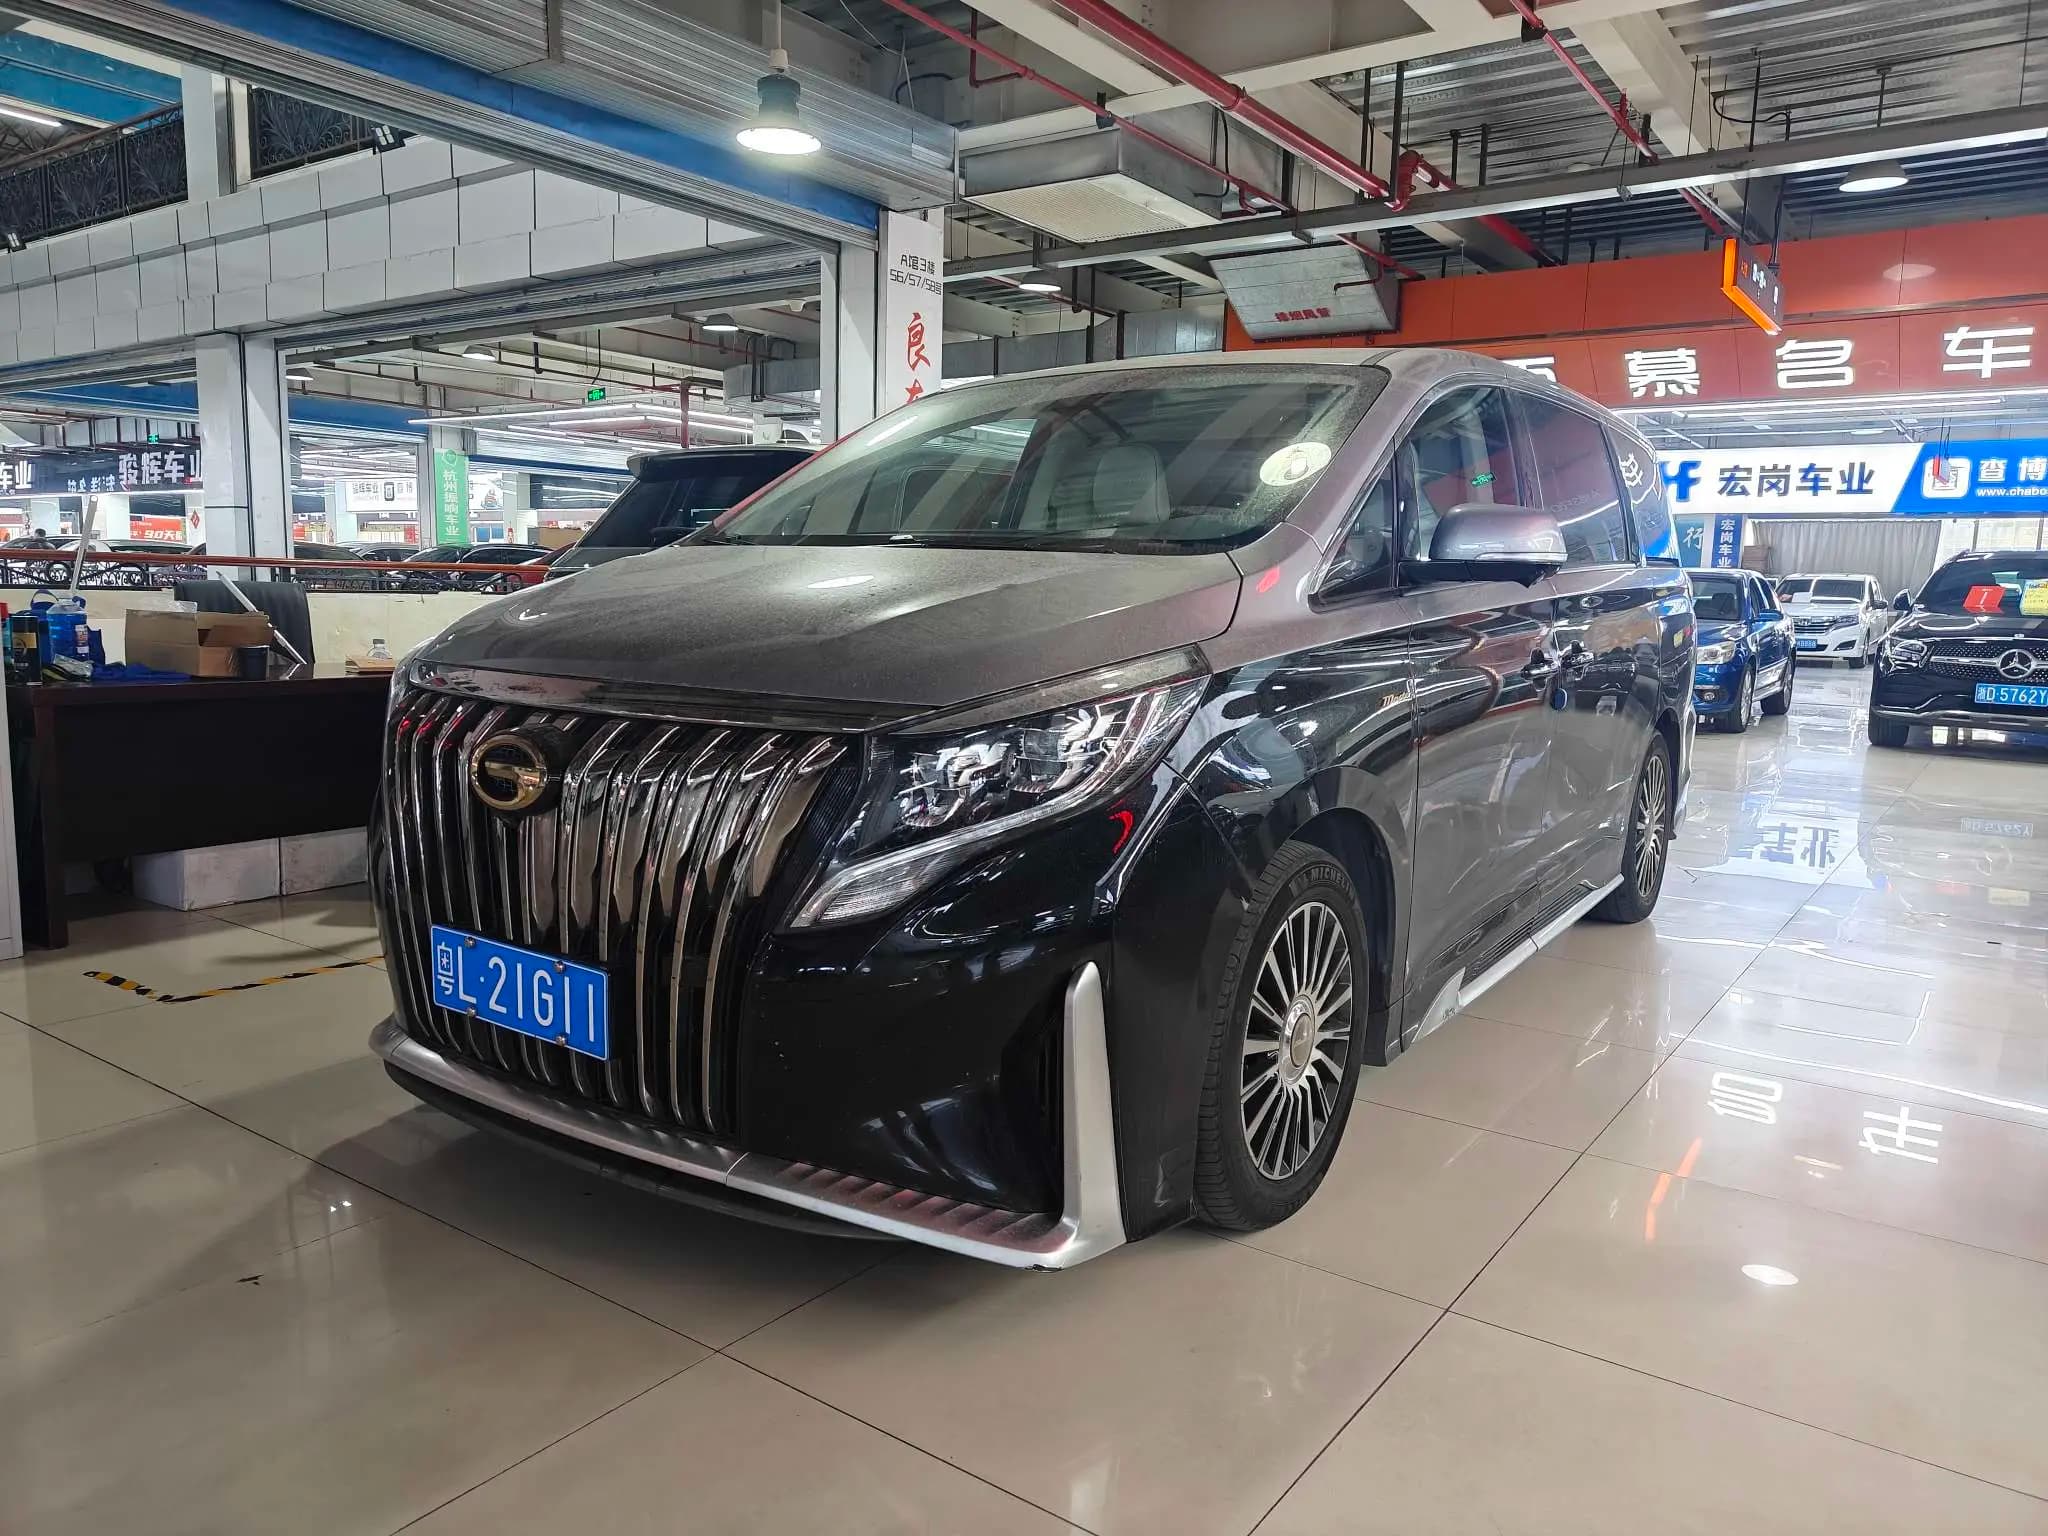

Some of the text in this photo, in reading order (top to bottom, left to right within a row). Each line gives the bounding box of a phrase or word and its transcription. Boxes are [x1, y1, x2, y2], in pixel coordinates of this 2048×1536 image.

[1716, 461, 1876, 498] 宏岗车业
[1716, 518, 1736, 568] 宏岗车业
